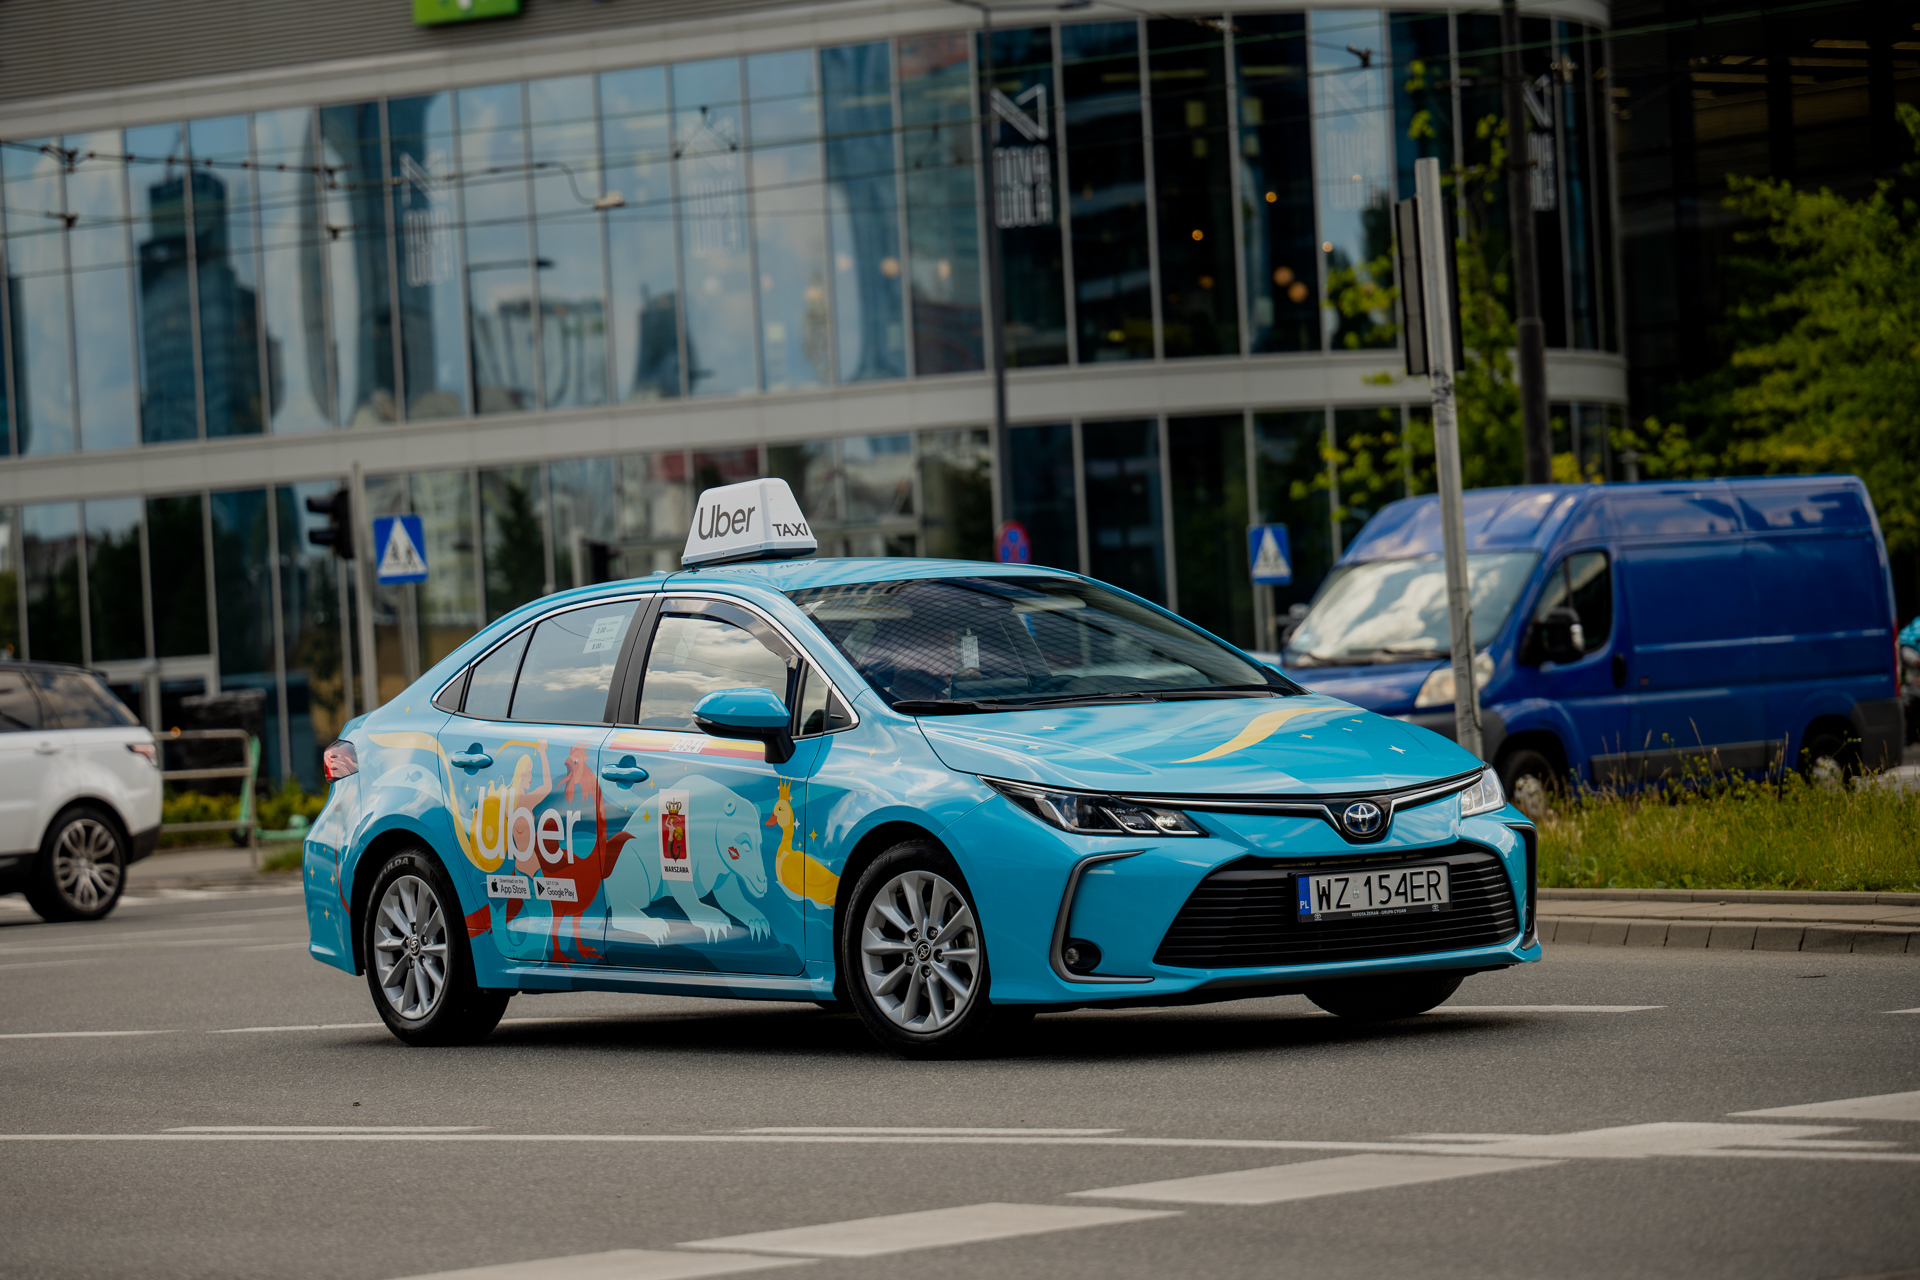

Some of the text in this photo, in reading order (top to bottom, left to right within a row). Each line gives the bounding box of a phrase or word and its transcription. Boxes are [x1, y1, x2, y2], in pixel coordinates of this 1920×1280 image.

[698, 504, 755, 540] Uber
[772, 523, 809, 536] TAXI
[671, 739, 706, 752] 24941
[476, 786, 581, 864] Uber
[664, 865, 690, 873] WARSZAWA
[501, 885, 527, 895] App Store
[547, 887, 574, 898] Google Play
[1316, 869, 1442, 910] WZ 154ER
[1299, 900, 1309, 909] PL
